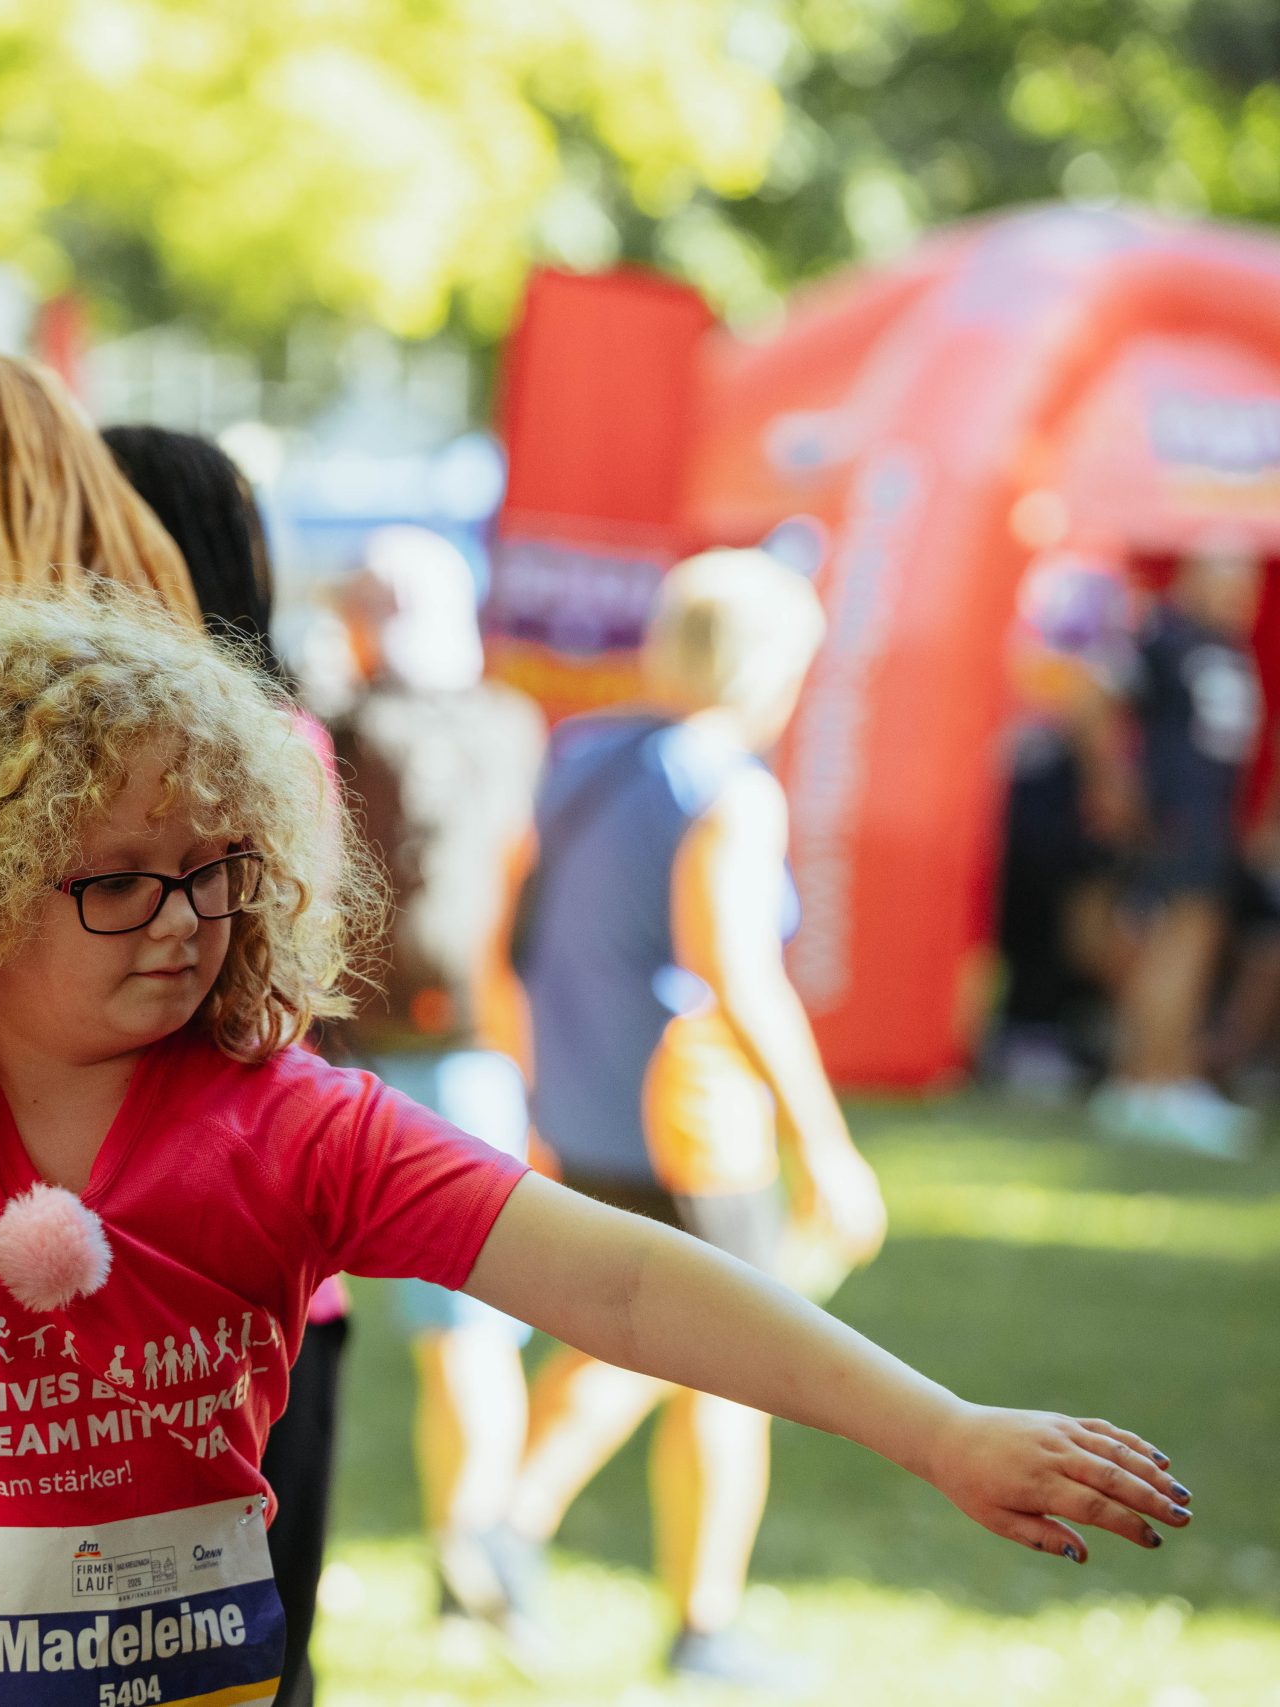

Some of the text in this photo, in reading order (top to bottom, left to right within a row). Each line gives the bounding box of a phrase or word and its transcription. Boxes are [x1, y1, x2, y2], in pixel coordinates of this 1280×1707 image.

[87, 1408, 152, 1448] MIT
[38, 1460, 133, 1495] stärker!
[78, 1541, 99, 1552] dm
[76, 1563, 113, 1575] FIRMEN
[77, 1576, 114, 1592] LAUF
[99, 1674, 162, 1707] 5404
